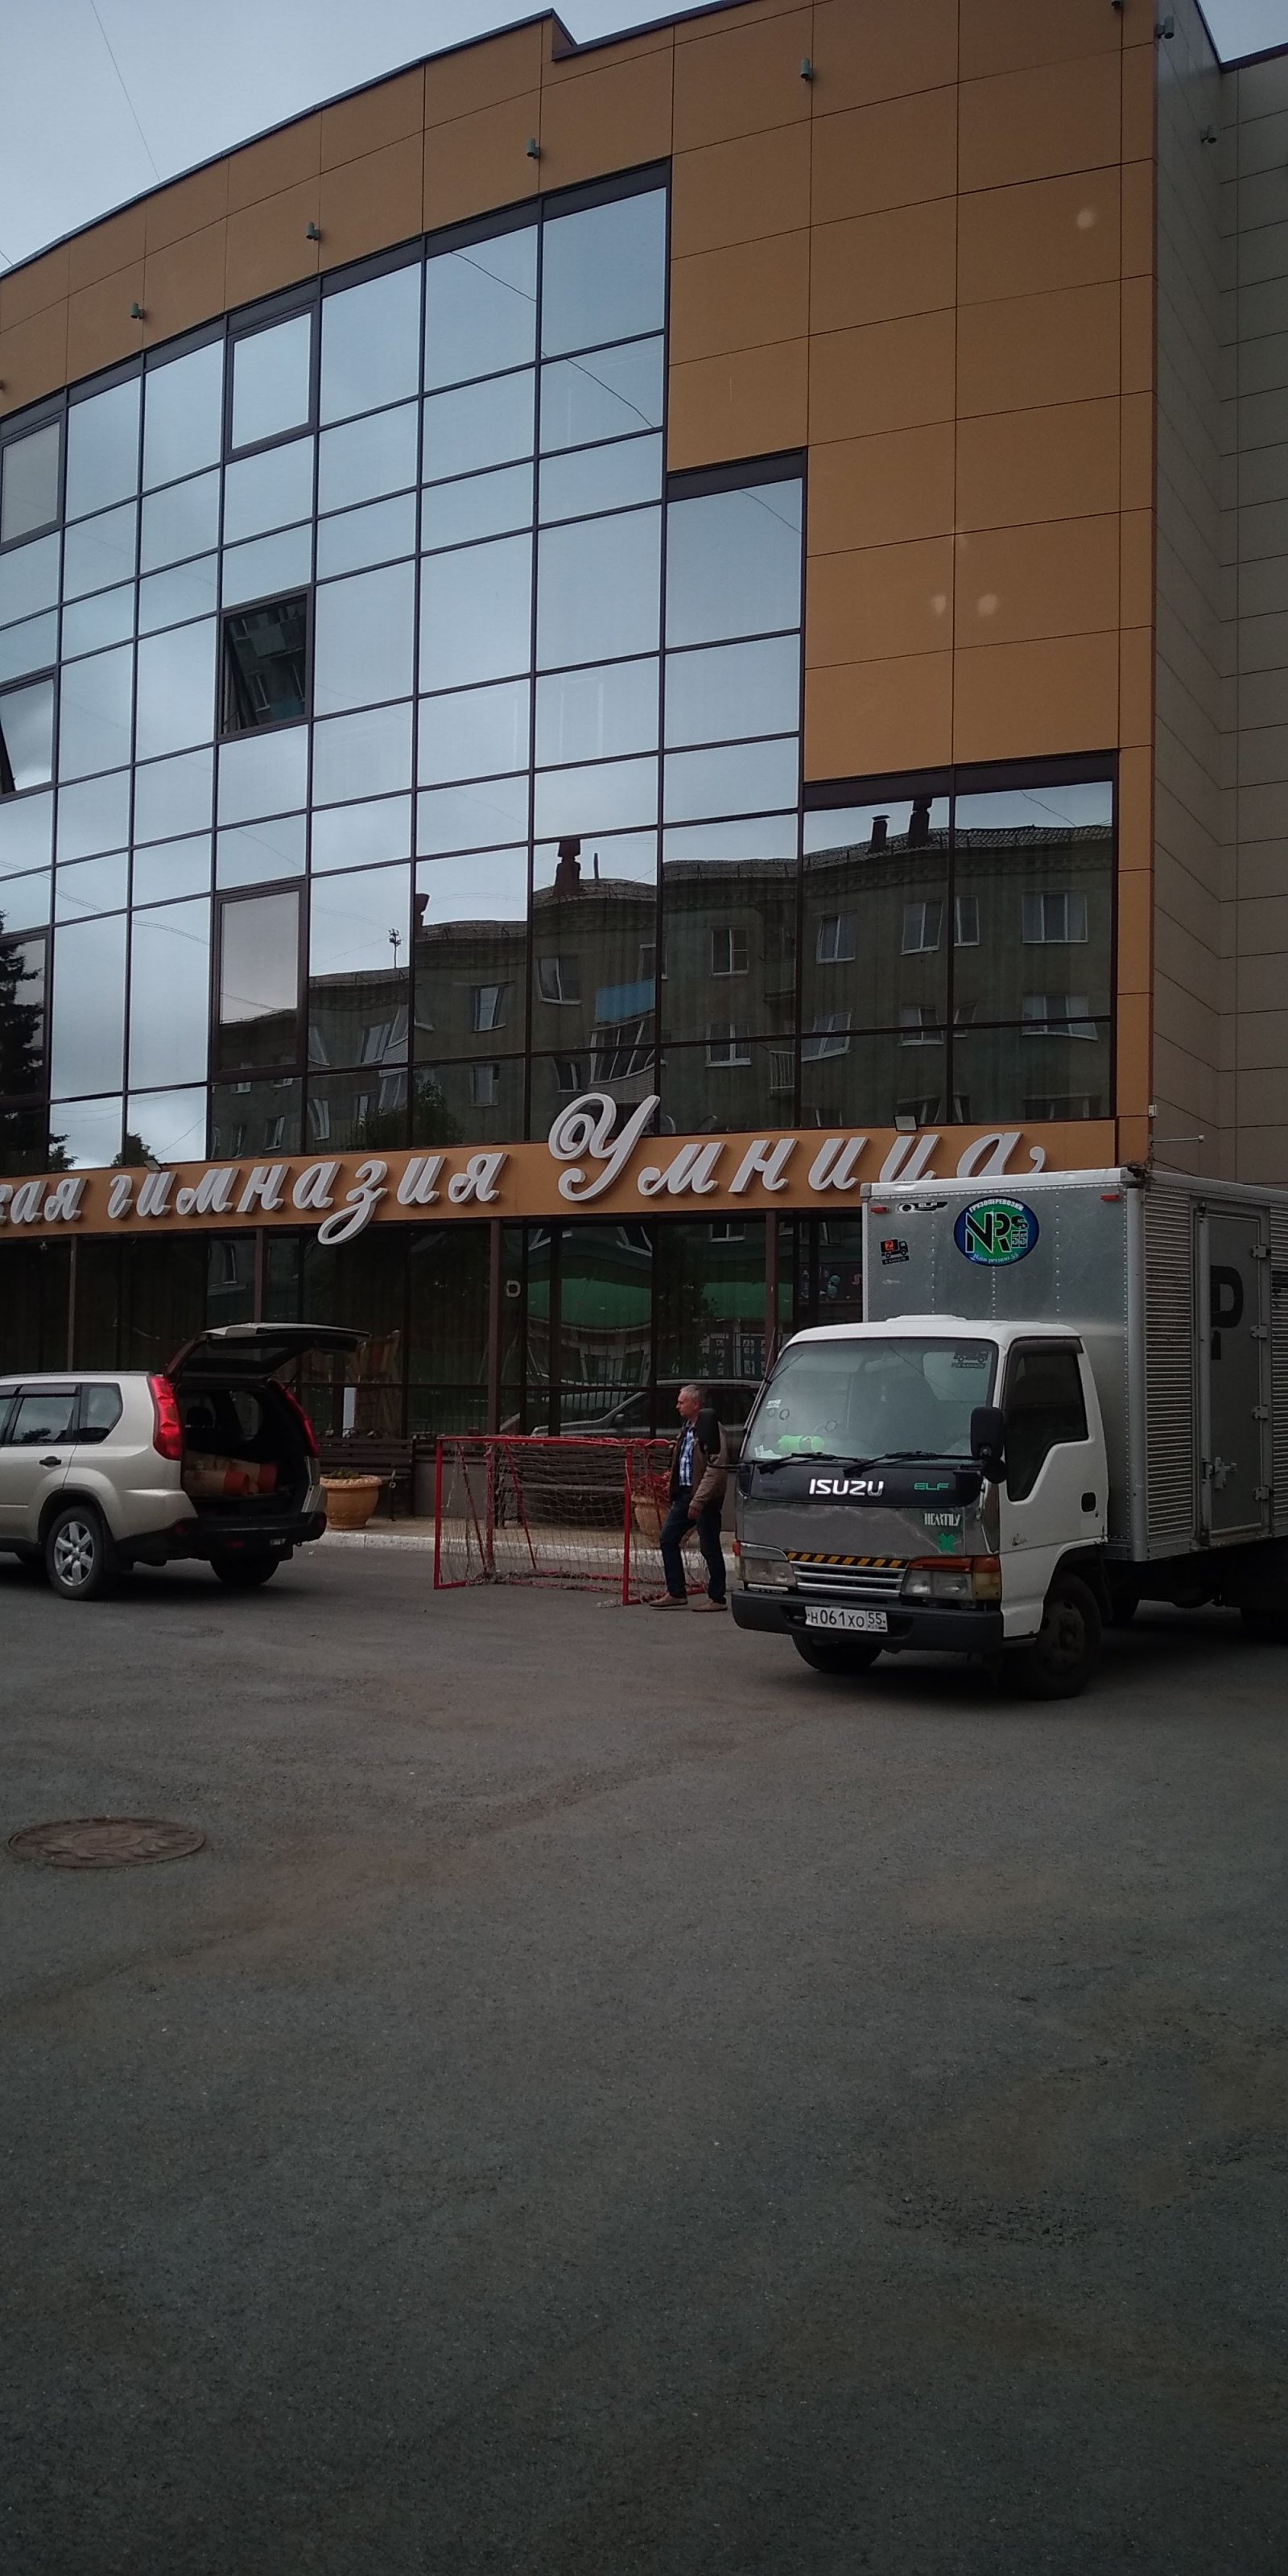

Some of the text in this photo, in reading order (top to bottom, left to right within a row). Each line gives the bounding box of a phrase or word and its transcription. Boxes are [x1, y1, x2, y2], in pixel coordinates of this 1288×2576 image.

[107, 1152, 510, 1245] гимназия
[968, 1198, 1025, 1213] ГРУЗОПЕРЕВОЗКИ
[809, 1479, 883, 1496] ISUZU
[914, 1481, 950, 1492] ELF
